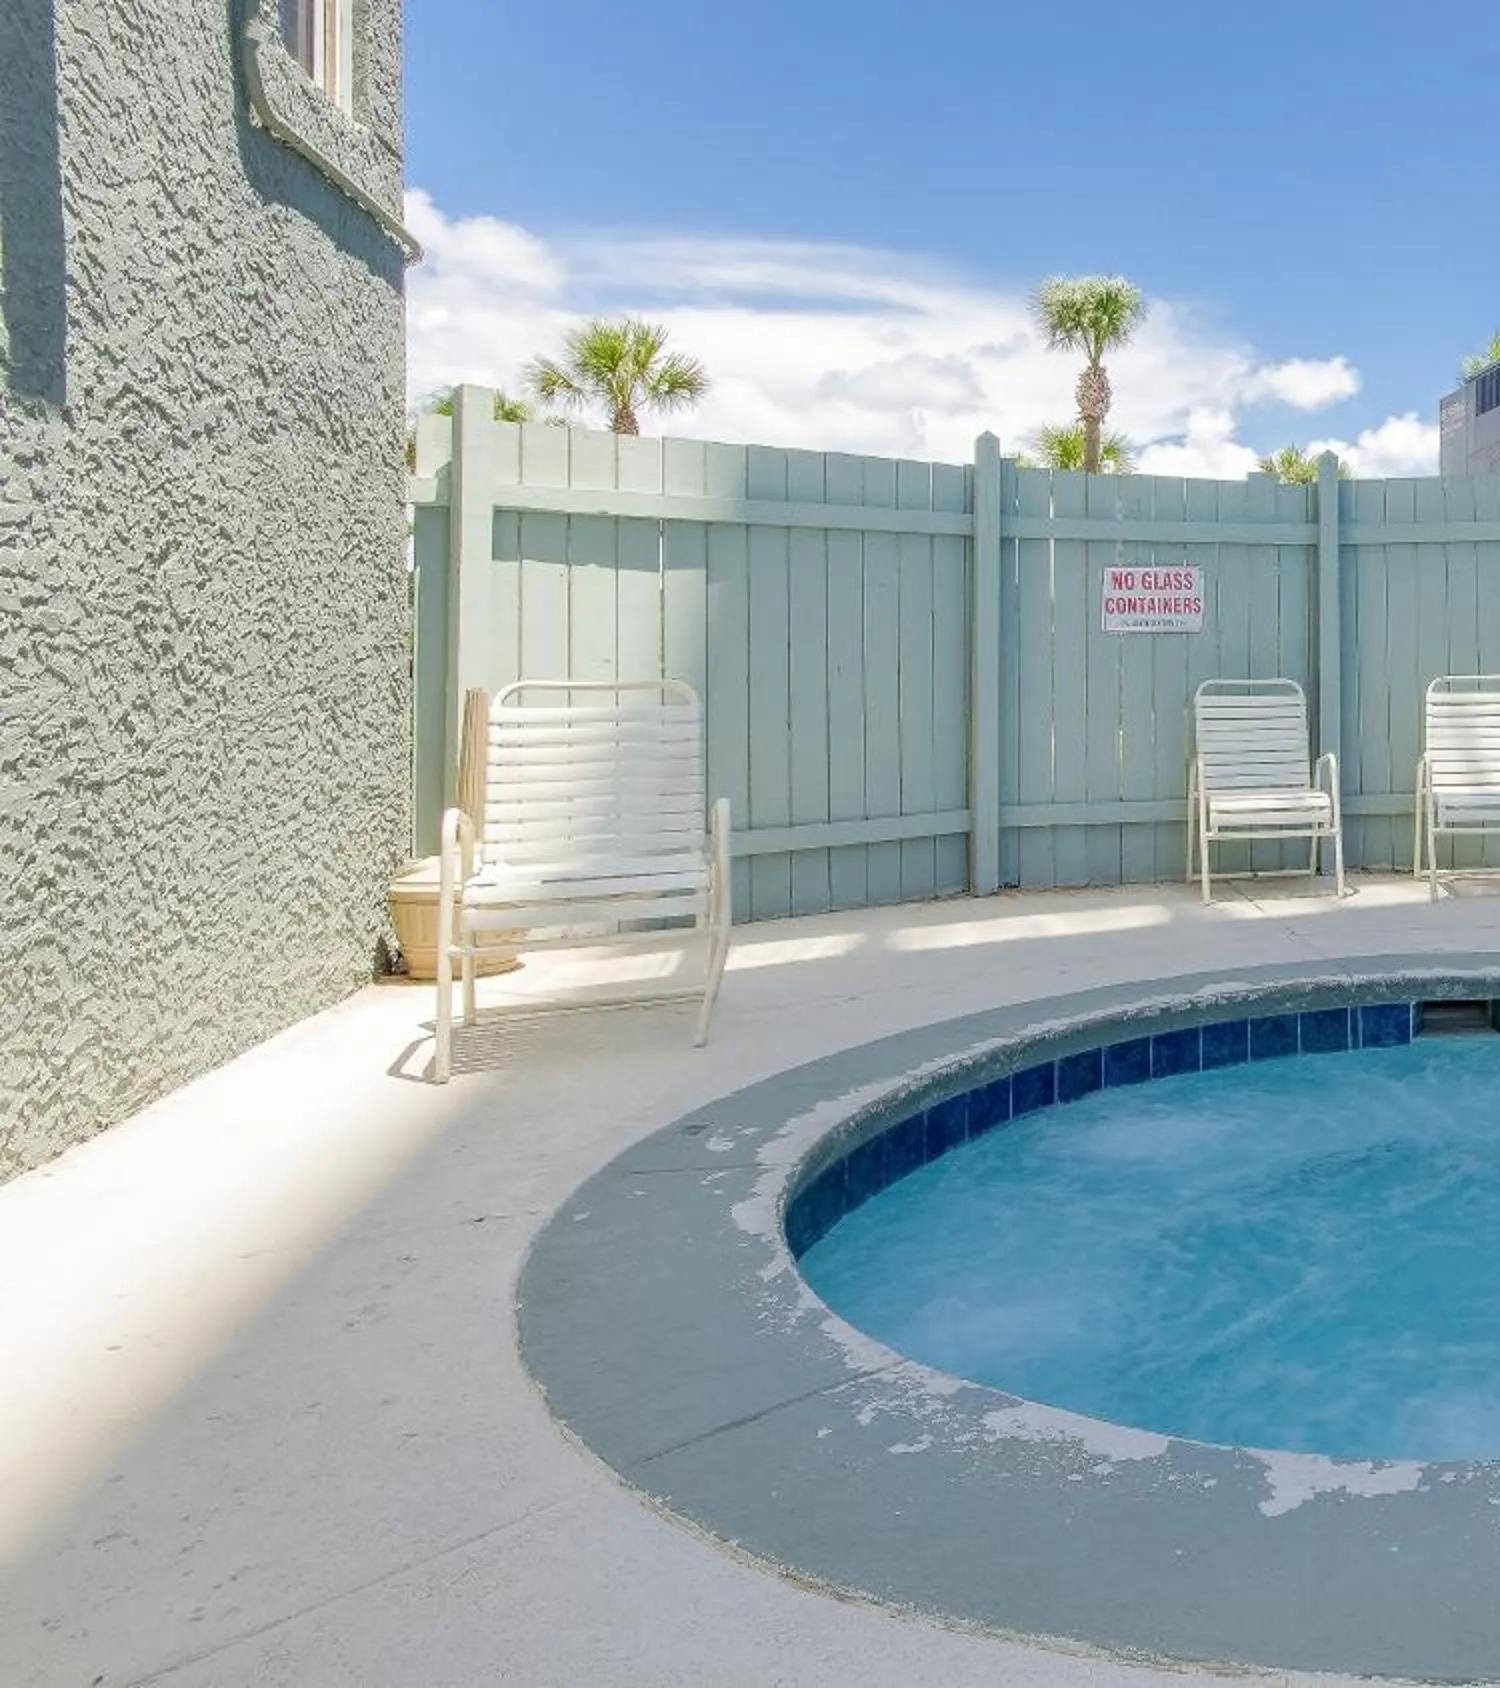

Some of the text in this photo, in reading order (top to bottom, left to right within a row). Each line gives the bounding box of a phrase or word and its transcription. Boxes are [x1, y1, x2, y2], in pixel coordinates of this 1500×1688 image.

[1111, 571, 1193, 591] NO GLASS
[1105, 597, 1201, 615] CONTAINERS
